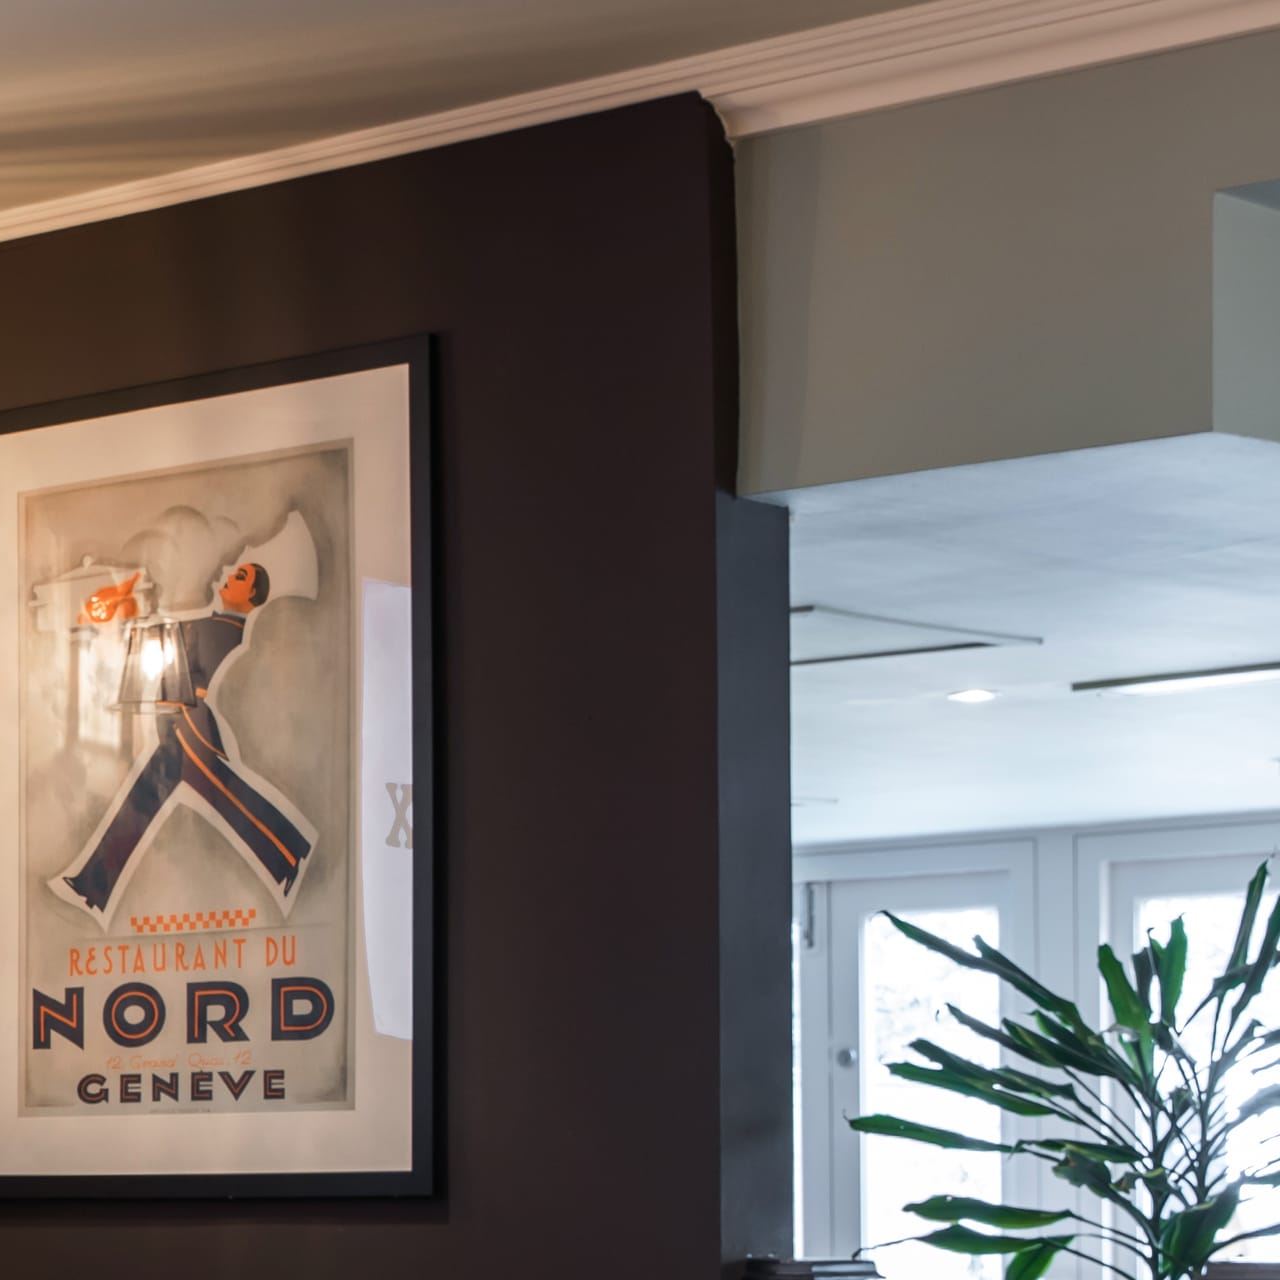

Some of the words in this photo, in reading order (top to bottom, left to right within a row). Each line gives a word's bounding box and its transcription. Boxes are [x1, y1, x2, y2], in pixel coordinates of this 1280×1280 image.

[68, 938, 247, 977] RESTAURANT
[265, 935, 297, 968] DU
[32, 976, 335, 1050] NORD
